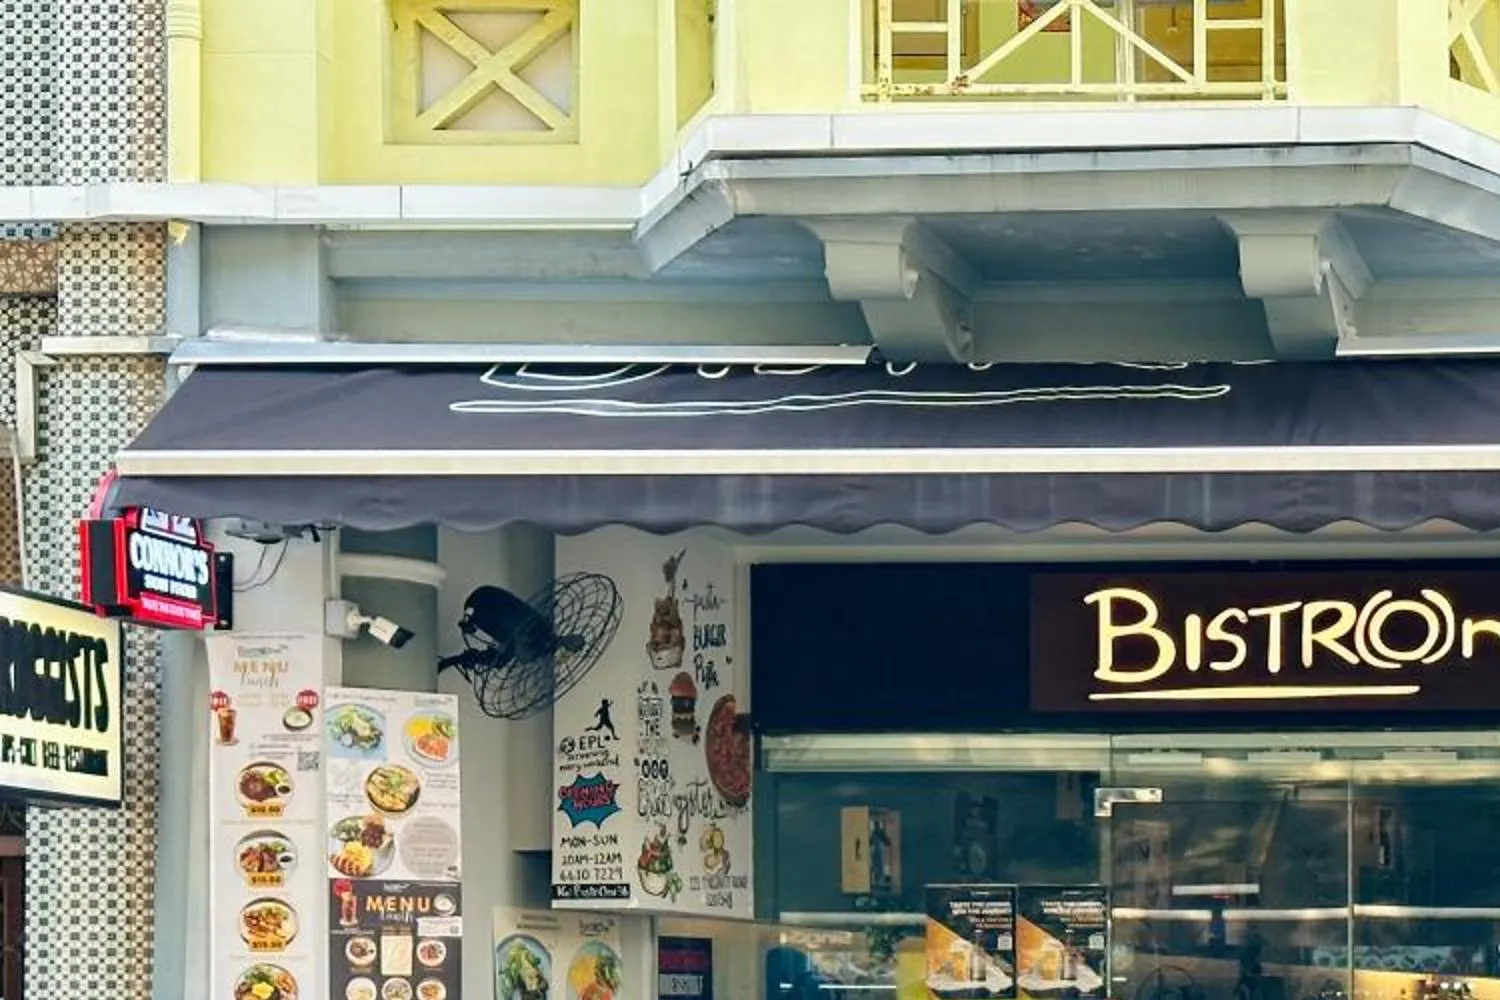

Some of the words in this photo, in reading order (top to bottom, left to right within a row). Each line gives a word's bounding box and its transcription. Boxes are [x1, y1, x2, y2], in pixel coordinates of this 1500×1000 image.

[129, 531, 209, 585] CONNOR'S
[579, 736, 606, 750] EPL
[365, 895, 430, 912] MENU
